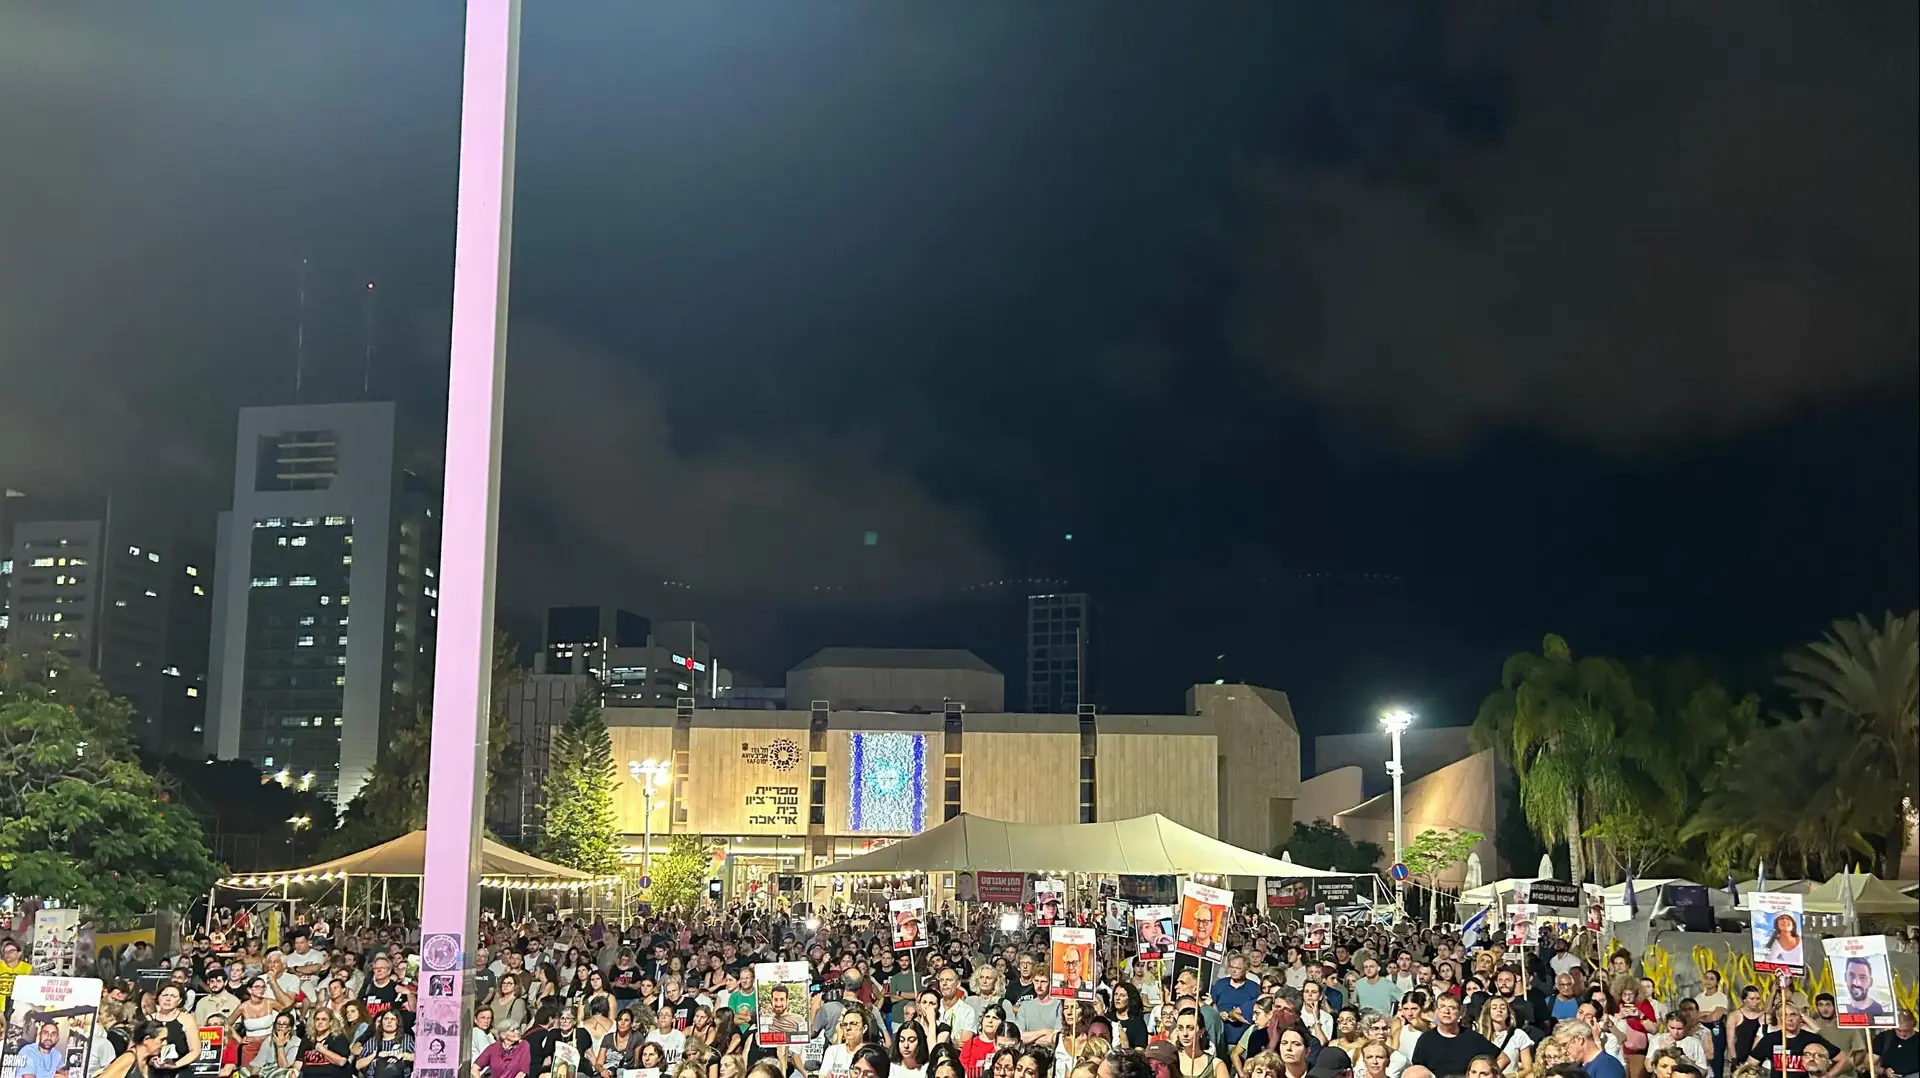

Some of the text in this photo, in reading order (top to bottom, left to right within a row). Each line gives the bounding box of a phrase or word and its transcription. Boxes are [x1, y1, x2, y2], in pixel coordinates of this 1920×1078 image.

[755, 786, 798, 795] ספריית
[776, 806, 798, 815] בית
[749, 815, 798, 824] אריאלה
[1531, 883, 1578, 893] BRING THEM
[1532, 892, 1575, 902] HOME NOW
[2, 1054, 27, 1067] BRING
